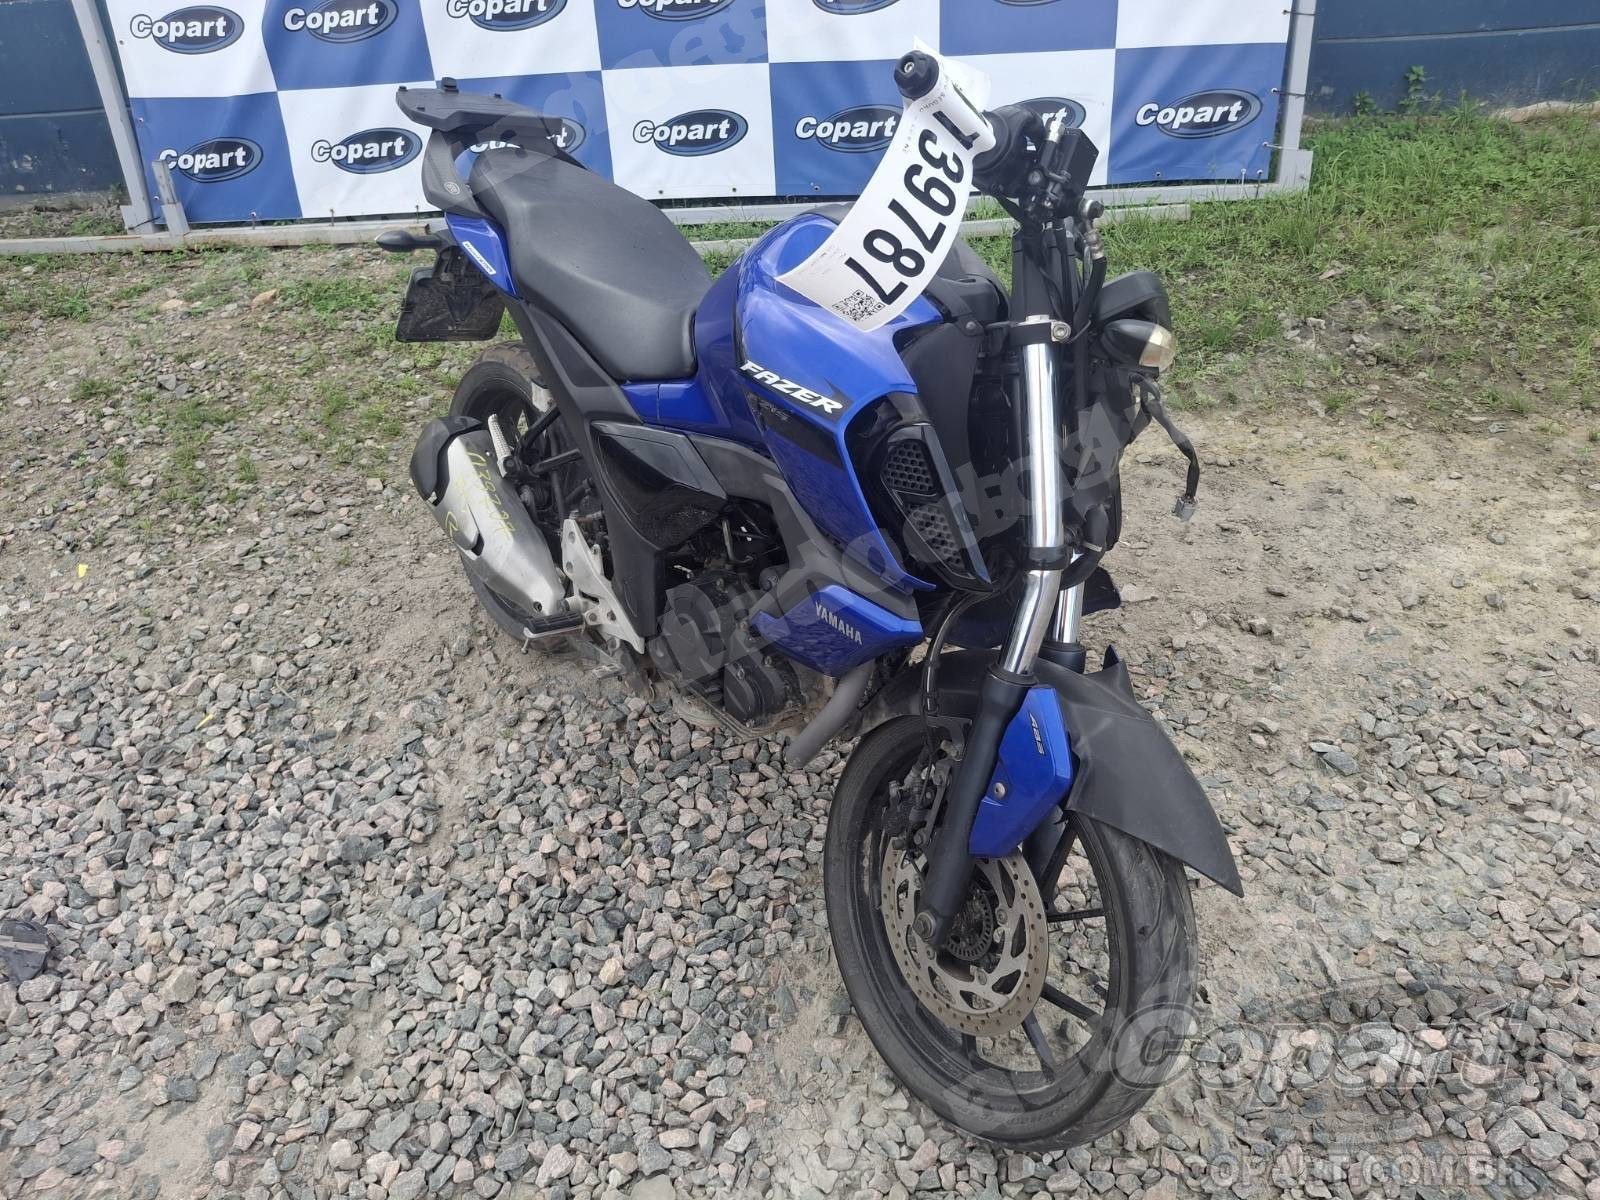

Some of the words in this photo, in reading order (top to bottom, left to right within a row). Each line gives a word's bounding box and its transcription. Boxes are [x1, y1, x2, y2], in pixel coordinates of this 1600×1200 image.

[130, 14, 227, 43] Copart
[284, 3, 379, 33] Copart
[795, 115, 897, 143] Copart
[1135, 100, 1243, 129] Copart
[633, 118, 730, 146] Copart
[312, 136, 405, 164] Copart
[740, 359, 844, 414] FAZER
[815, 601, 863, 645] YAMAHA
